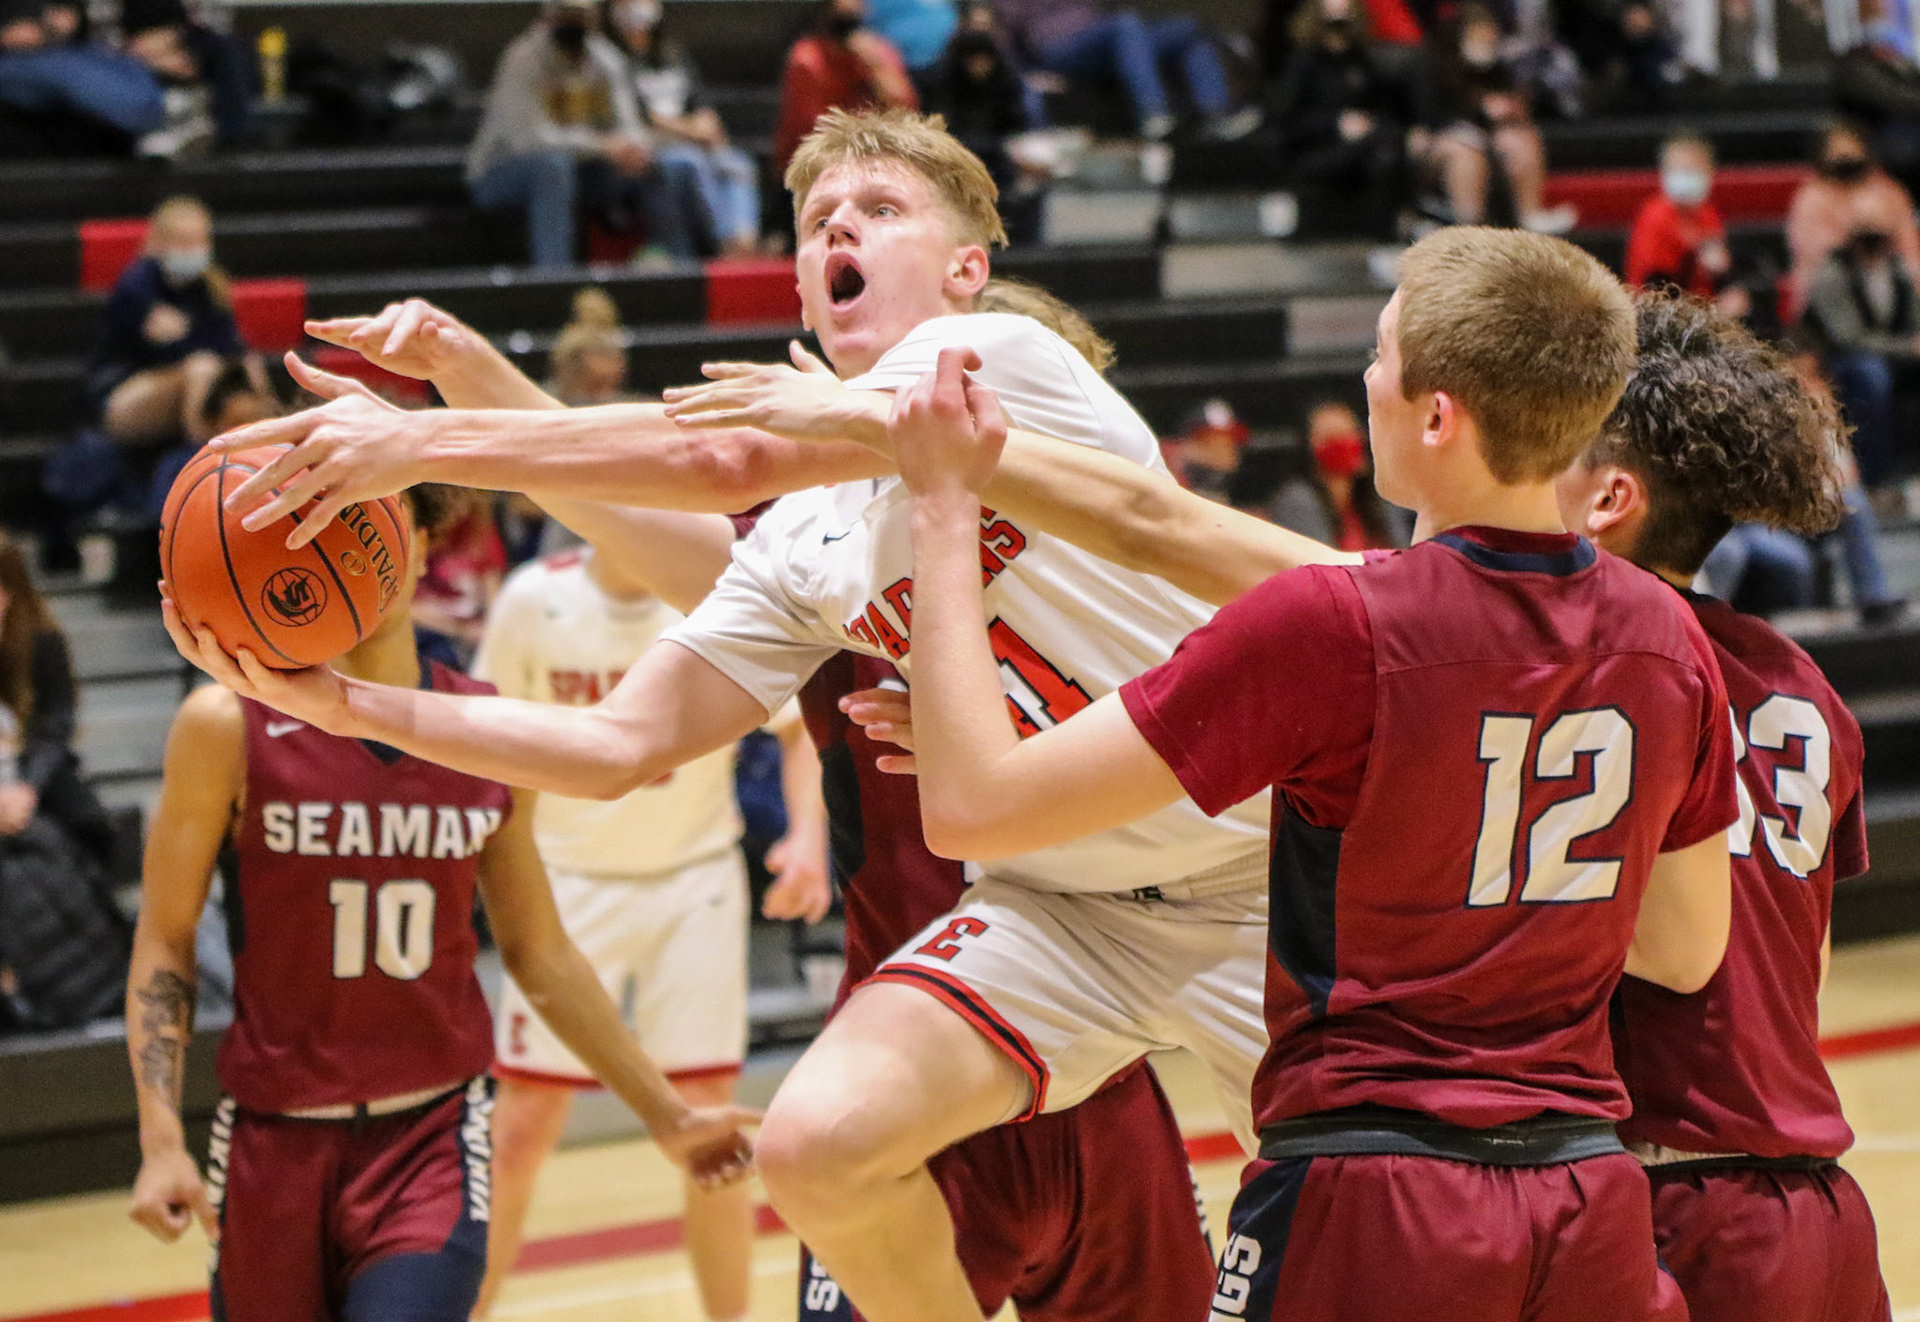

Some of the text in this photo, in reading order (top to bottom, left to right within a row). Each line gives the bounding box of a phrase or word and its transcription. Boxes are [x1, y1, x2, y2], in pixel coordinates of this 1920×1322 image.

[262, 802, 502, 860] SEAMAN
[1464, 704, 1638, 909] 12
[328, 878, 436, 981] 10
[912, 917, 990, 963] E
